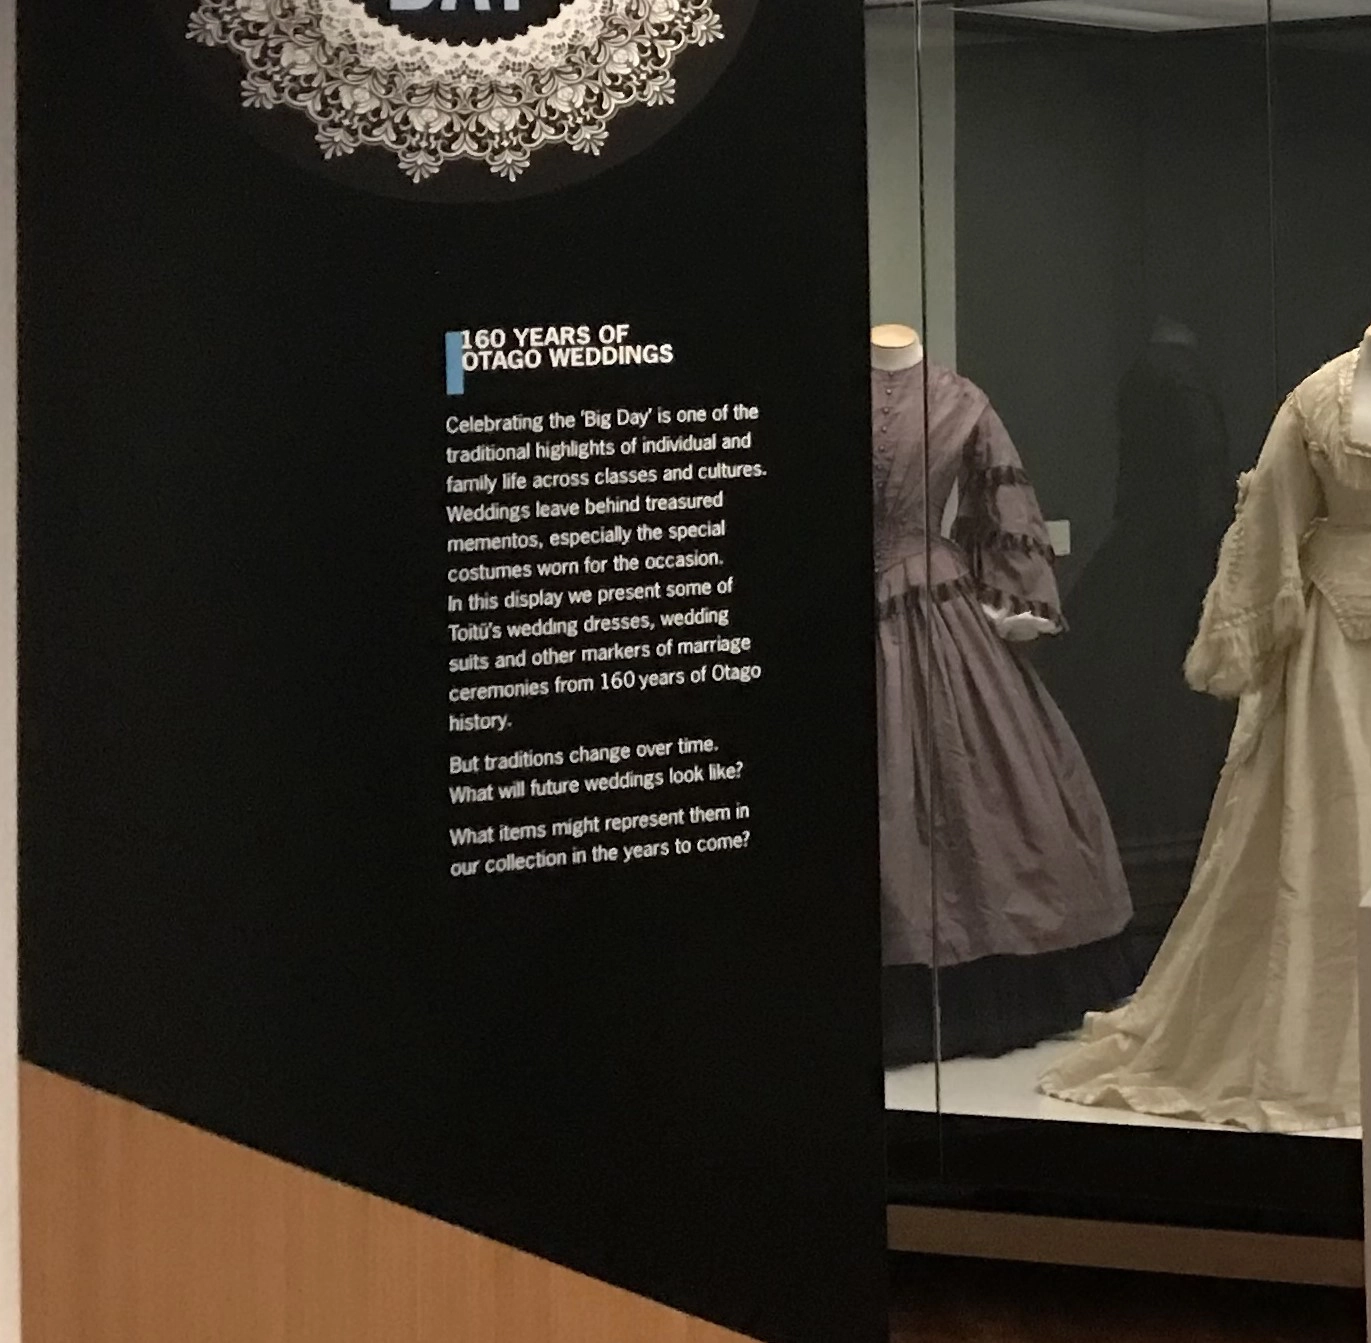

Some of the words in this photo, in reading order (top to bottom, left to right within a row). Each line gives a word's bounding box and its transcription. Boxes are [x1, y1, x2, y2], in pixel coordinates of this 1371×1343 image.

[462, 329, 506, 350] 160
[513, 326, 591, 348] YEARS
[599, 324, 630, 344] OF
[462, 348, 542, 371] OTAGO
[550, 344, 674, 368] WEDDINGS
[446, 414, 543, 434] Celebrating
[549, 412, 575, 429] the
[658, 407, 671, 423] is
[677, 409, 706, 422] one
[712, 404, 728, 421] of
[733, 404, 758, 420] the
[446, 442, 530, 463] traditional
[536, 440, 615, 461] highlights
[621, 437, 637, 454] of
[643, 433, 716, 453] individual
[722, 431, 751, 449] and
[447, 474, 497, 494] family
[503, 472, 527, 489] life
[533, 473, 589, 488] across
[595, 467, 657, 485] classes
[663, 464, 693, 481] and
[698, 463, 767, 479] cultures.
[446, 503, 530, 522] Weddings
[536, 501, 579, 517] leave
[585, 495, 639, 514] behind
[645, 490, 723, 511] treasured
[448, 533, 543, 552] mementos,
[550, 525, 632, 548] especially
[636, 524, 662, 541] the
[669, 520, 725, 541] special
[448, 564, 532, 582] costumes
[537, 561, 579, 576] worn
[584, 556, 608, 573] for
[613, 554, 639, 571] the
[645, 550, 723, 569] occasion.
[448, 596, 462, 611] In
[468, 593, 498, 610] this
[505, 589, 563, 609] display
[568, 590, 592, 604] we
[598, 582, 661, 605] present
[666, 582, 711, 597] some
[717, 576, 733, 594] of
[507, 618, 578, 637] wedding
[584, 615, 655, 632] dresses,
[660, 607, 729, 626] wedding
[449, 654, 489, 672] suits
[495, 650, 526, 668] and
[532, 648, 576, 665] other
[582, 643, 650, 661] markers
[656, 638, 673, 657] of
[678, 635, 751, 654] marriage
[449, 680, 549, 701] ceremonies
[555, 676, 593, 693] from
[601, 670, 635, 690] 160
[639, 671, 684, 690] years
[691, 665, 707, 683] of
[712, 664, 761, 682] Otago
[449, 714, 511, 731] history.
[450, 755, 480, 774] But
[484, 750, 564, 770] traditions
[569, 746, 630, 763] change
[636, 742, 673, 757] over
[678, 738, 718, 754] time.
[449, 784, 493, 804] What
[498, 781, 525, 799] will
[530, 779, 579, 796] future
[584, 771, 664, 791] weddings
[670, 765, 704, 784] look
[709, 761, 743, 780] like?
[449, 827, 494, 846] What
[499, 825, 546, 841] items
[552, 817, 600, 838] might
[605, 809, 684, 832] represent
[689, 806, 730, 823] them
[736, 802, 749, 819] in
[451, 860, 480, 876] our
[485, 851, 566, 873] collection
[572, 847, 586, 864] in
[592, 845, 618, 862] the
[623, 842, 669, 862] years
[675, 839, 691, 854] to
[697, 830, 750, 852] come?
